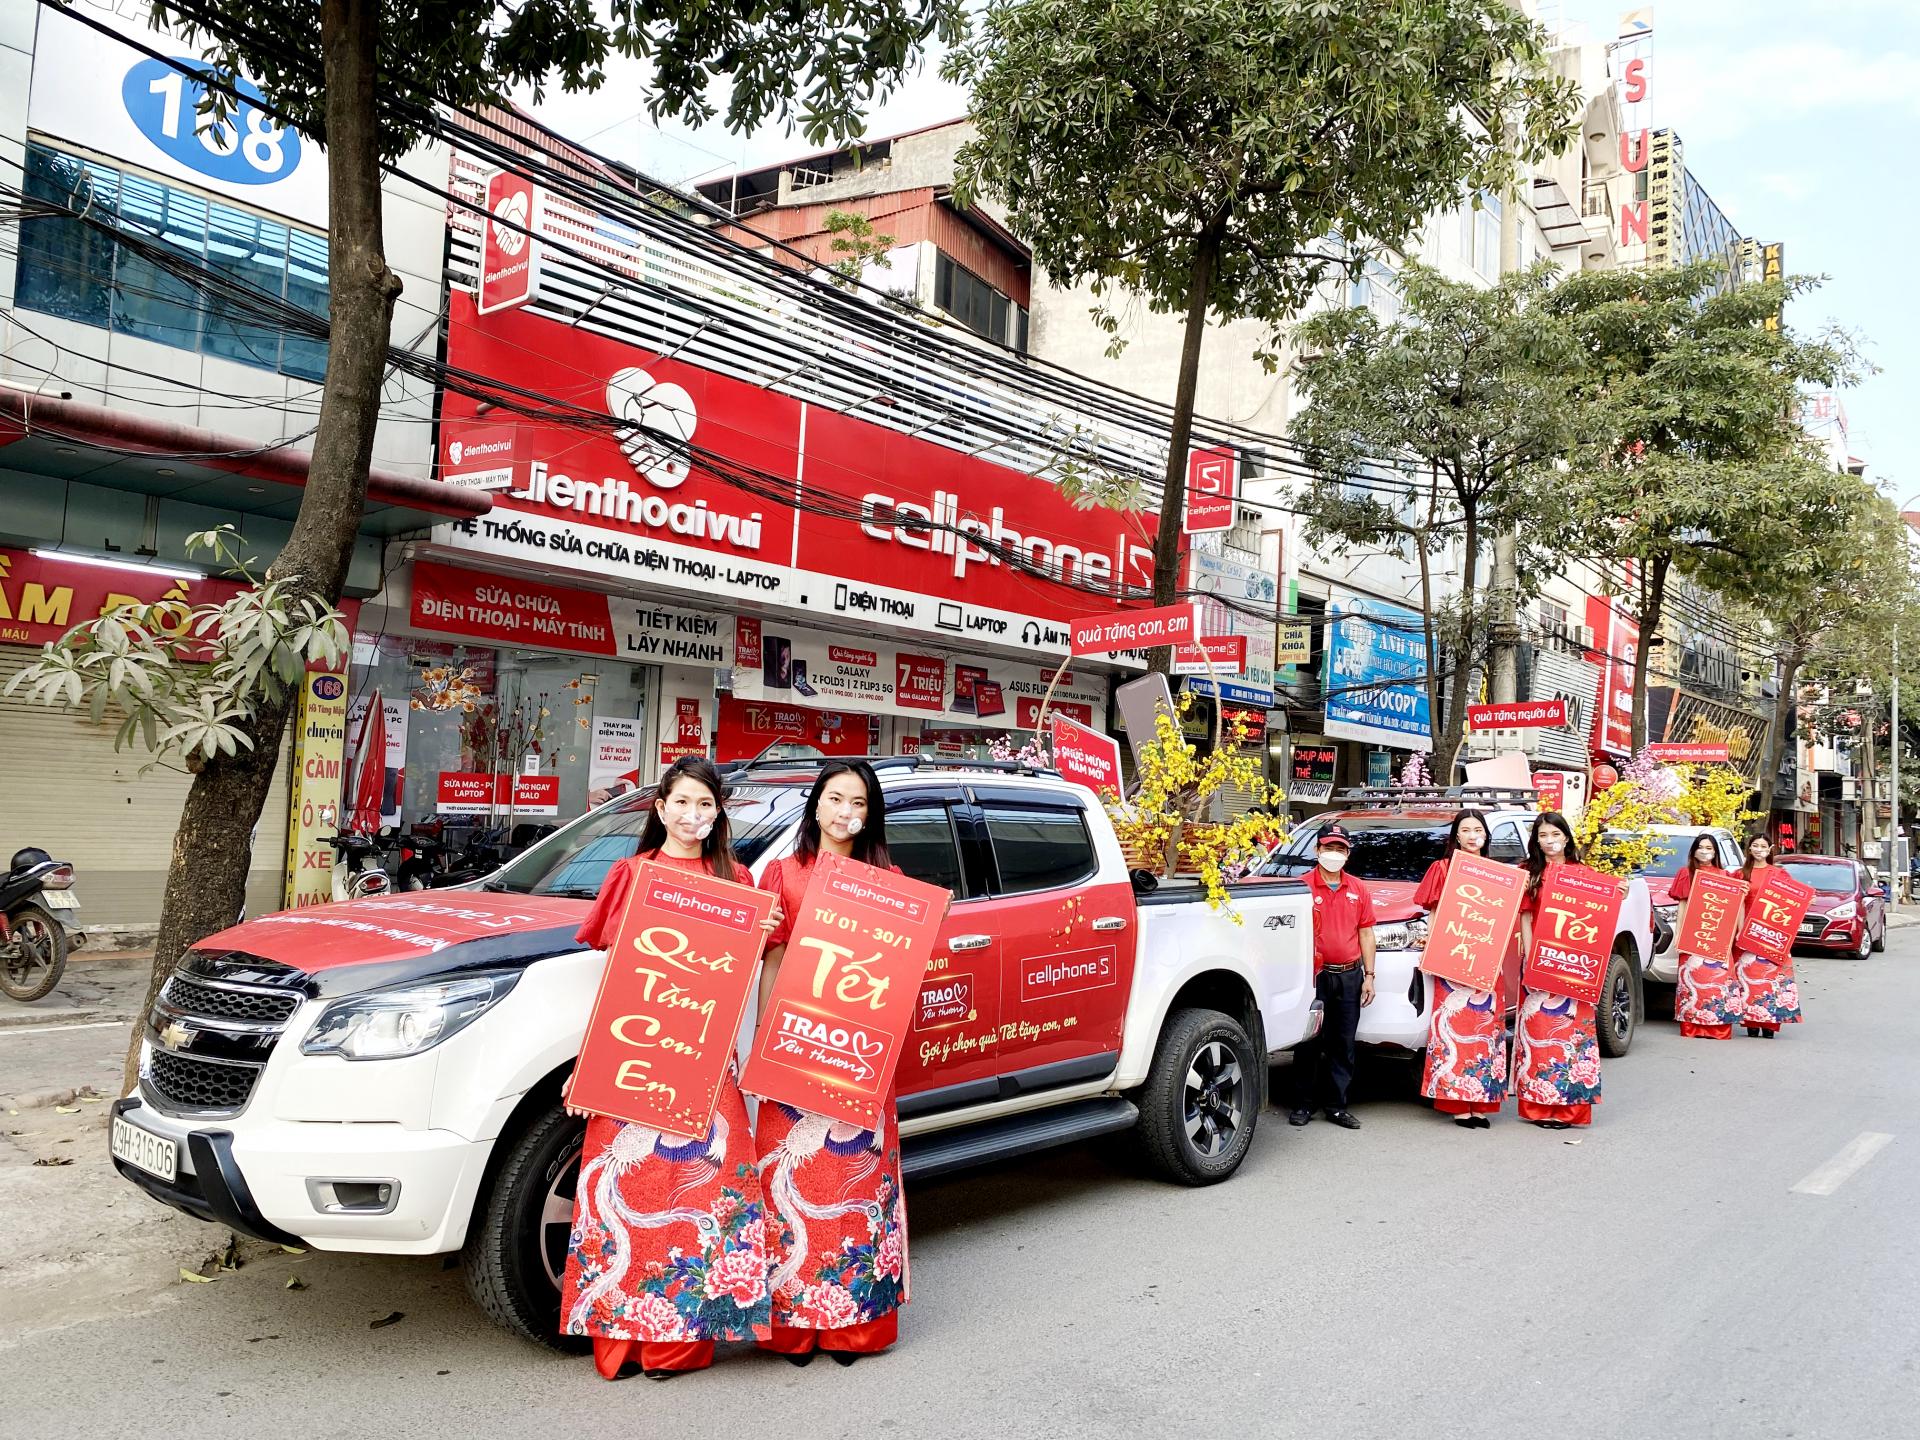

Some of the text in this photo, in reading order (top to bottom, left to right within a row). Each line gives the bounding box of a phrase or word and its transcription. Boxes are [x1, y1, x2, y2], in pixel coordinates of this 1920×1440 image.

[149, 72, 284, 173] 168
[485, 261, 528, 284] dienthoaivui
[464, 439, 512, 456] dienthoaivui
[1188, 505, 1231, 515] cellphone
[483, 519, 546, 547] THỐNG
[549, 529, 584, 554] SỬA
[586, 539, 630, 564] CHỮA
[633, 551, 669, 572] ĐIỆN
[672, 558, 717, 581] THOẠI
[726, 568, 781, 590] LAPTOP
[474, 585, 561, 615] SỬA CHỮA
[849, 590, 915, 619] ĐIỆN THOẠI
[420, 597, 605, 642] ĐIỆN THOẠI MÁY TÍNH
[636, 608, 717, 636] TIẾT KIỆM
[966, 614, 1008, 634] LAPTOP
[2, 628, 29, 641] MẬU
[1043, 623, 1058, 643] ÂM
[627, 633, 724, 661] LẤY NHANH
[836, 666, 871, 678] GALAXY
[899, 664, 911, 688] 7
[316, 680, 341, 697] 168
[812, 674, 893, 693] Z FOLD3 Z FLIP3 5G
[912, 675, 942, 695] TRIỆU
[1008, 681, 1030, 693] ASUS
[1032, 684, 1049, 694] FLIP
[911, 693, 931, 701] GALAXY
[1345, 682, 1418, 716] PHOTOCOPY
[603, 721, 620, 729] THAY
[774, 712, 795, 721] TRAO
[307, 722, 343, 743] chuyên
[680, 724, 701, 736] 126
[903, 743, 919, 754] 126
[1295, 748, 1334, 763] CHỤP ẢNH
[305, 753, 340, 779] CẦM
[1068, 760, 1087, 776] NĂM
[1085, 755, 1111, 772] MỪNG
[1295, 764, 1311, 779] THẺ
[444, 779, 460, 788] SỬA
[461, 781, 479, 789] MAC
[530, 783, 551, 791] NGAY
[1291, 782, 1331, 797] PHOTOCOPY
[302, 799, 314, 828] Ô
[302, 851, 332, 869] XE
[1456, 885, 1505, 908] Quà
[1551, 891, 1609, 913] TỪ 01 30/1
[1456, 901, 1496, 937] Tặng
[1758, 897, 1792, 927] Tết
[815, 907, 912, 950] TỪ 01 30/1
[1445, 920, 1495, 949] Người
[1545, 907, 1599, 945] Tết
[1750, 922, 1776, 938] TRAO
[633, 926, 740, 975] Quà
[1539, 945, 1580, 964] TRAO
[800, 936, 890, 1010] Tết
[925, 958, 948, 972] 0/01
[635, 967, 716, 1044] Tặng
[922, 987, 952, 1006] TRAO
[922, 1005, 965, 1022] Yêu thương
[610, 1014, 702, 1060] Con,
[781, 1011, 850, 1047] TRAO
[919, 1015, 1077, 1066] Gợi ý chọn quà Tết tặng con, em
[773, 1036, 867, 1082] Yêu thương
[614, 1059, 676, 1105] Em
